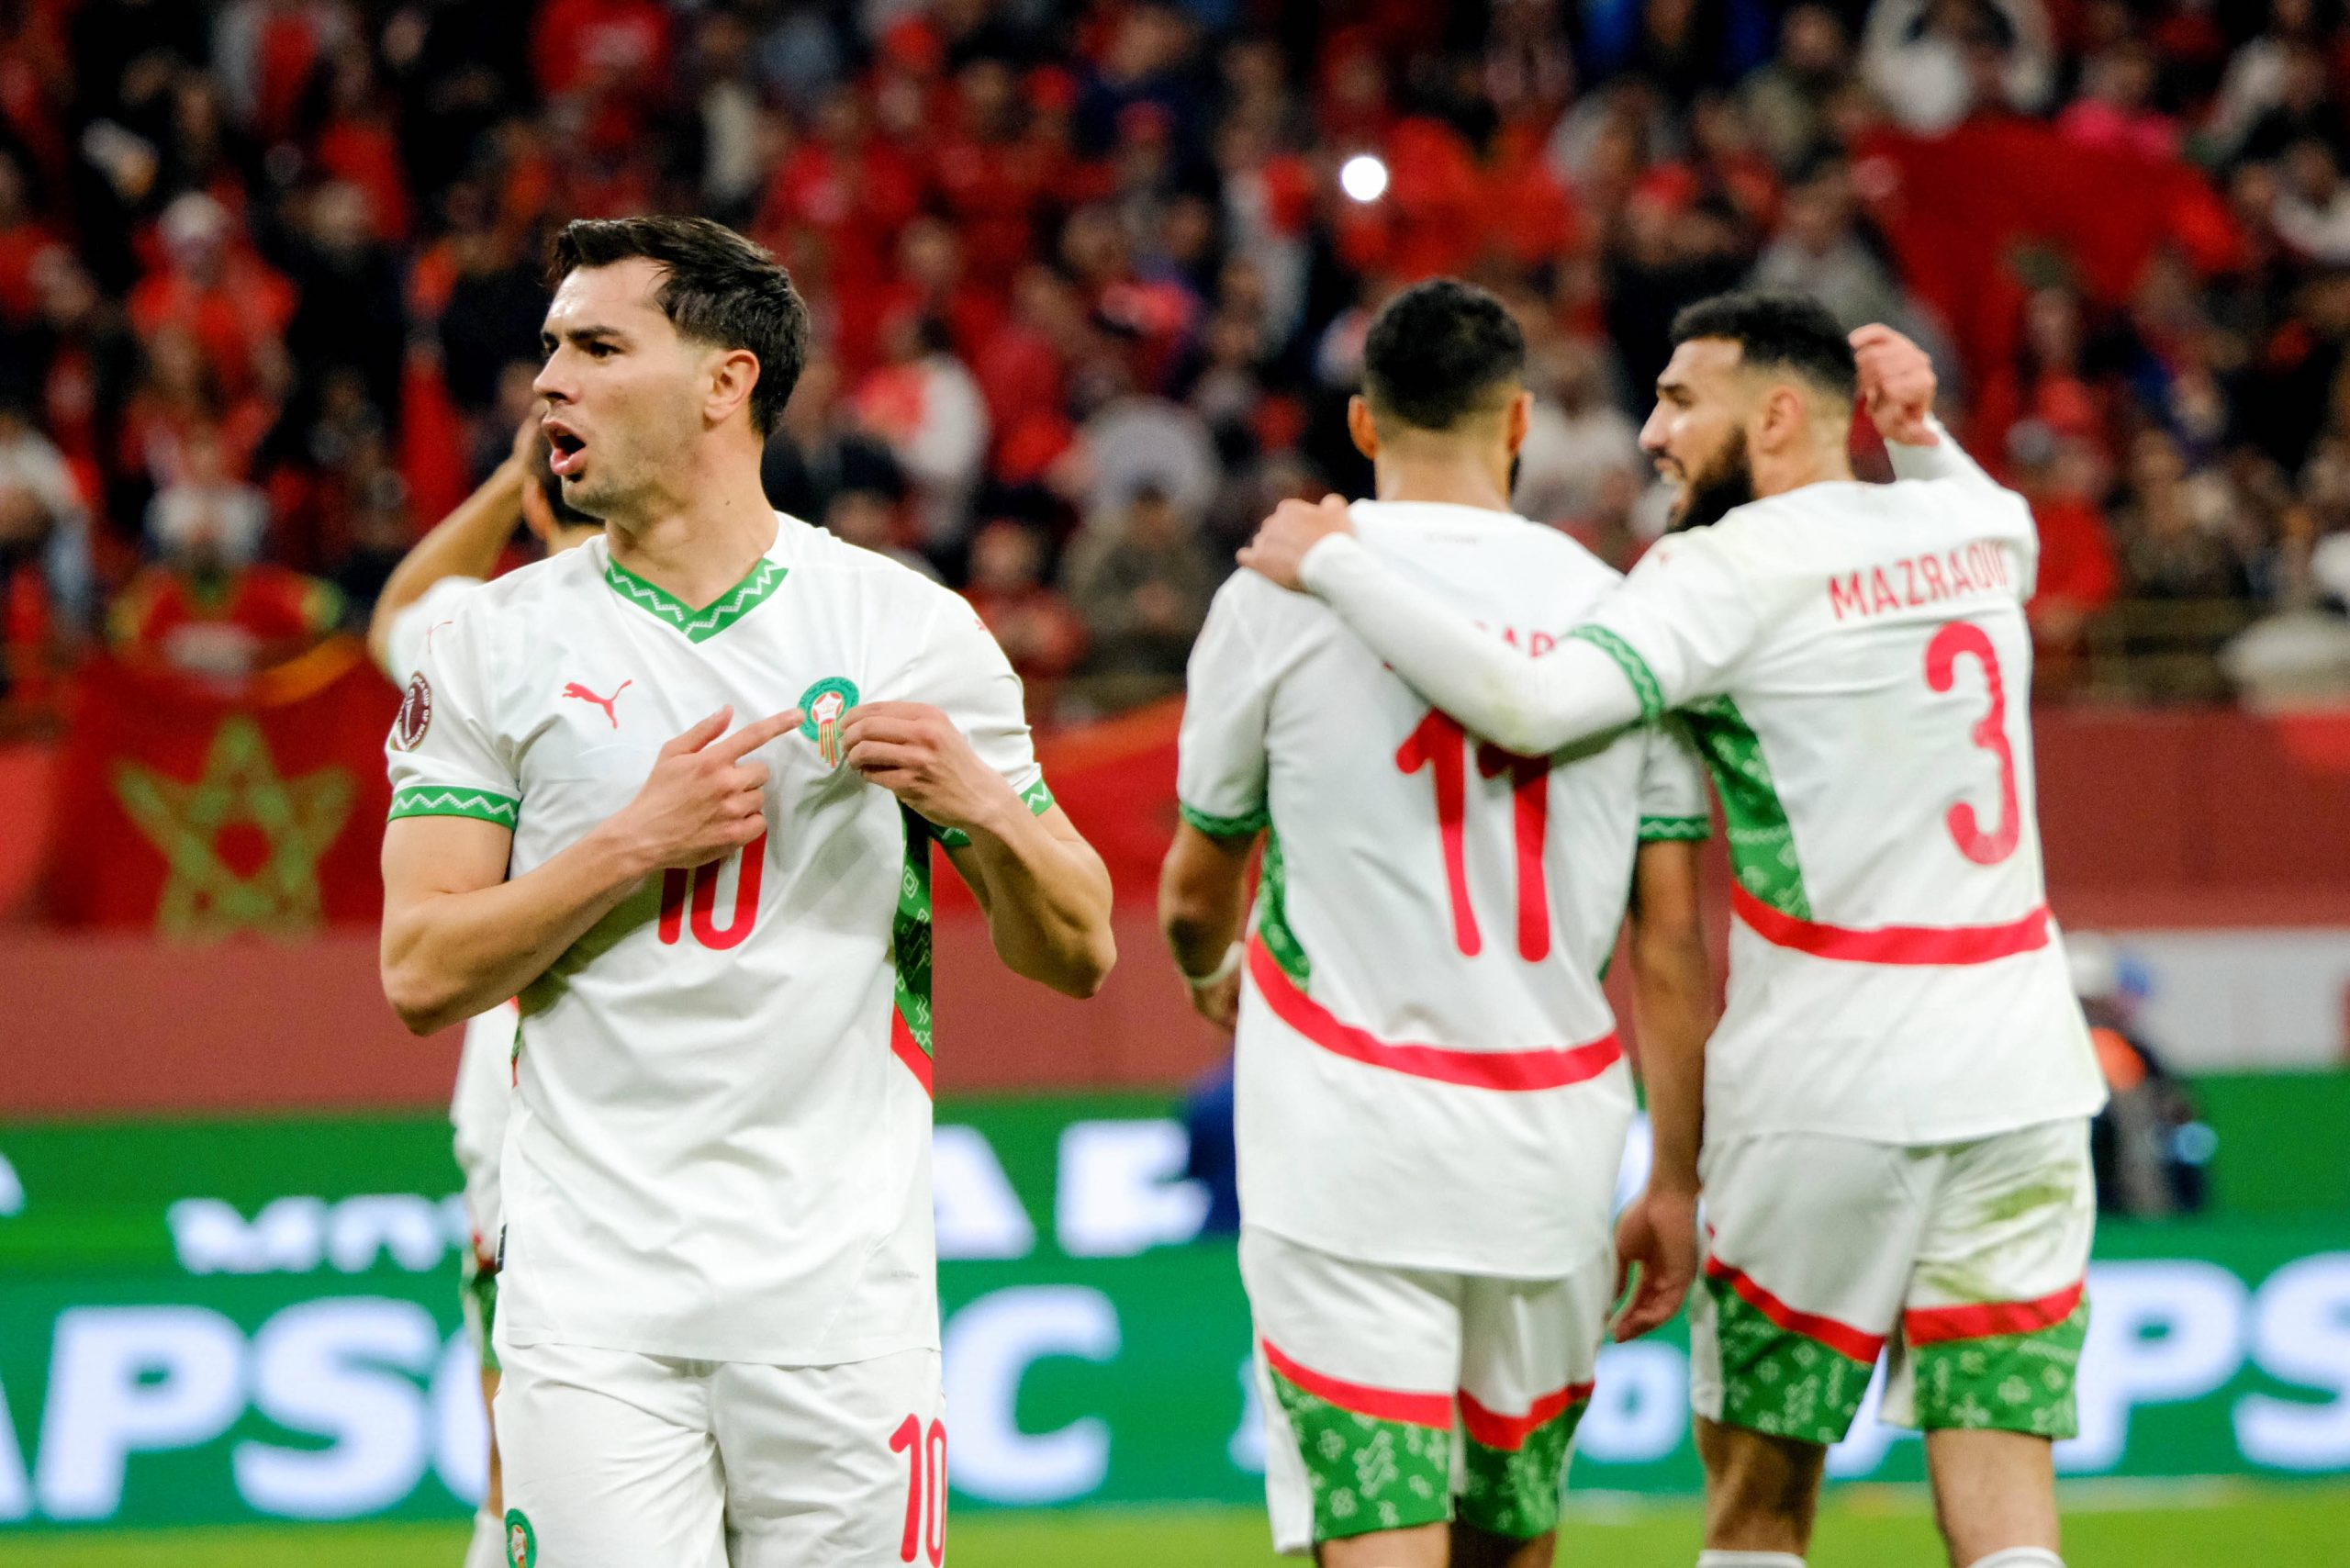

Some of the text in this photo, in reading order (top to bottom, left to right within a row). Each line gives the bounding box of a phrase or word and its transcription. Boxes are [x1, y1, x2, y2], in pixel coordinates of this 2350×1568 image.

[1394, 705, 1551, 963] 11
[1924, 620, 2020, 865] 3
[889, 1412, 947, 1568] 10
